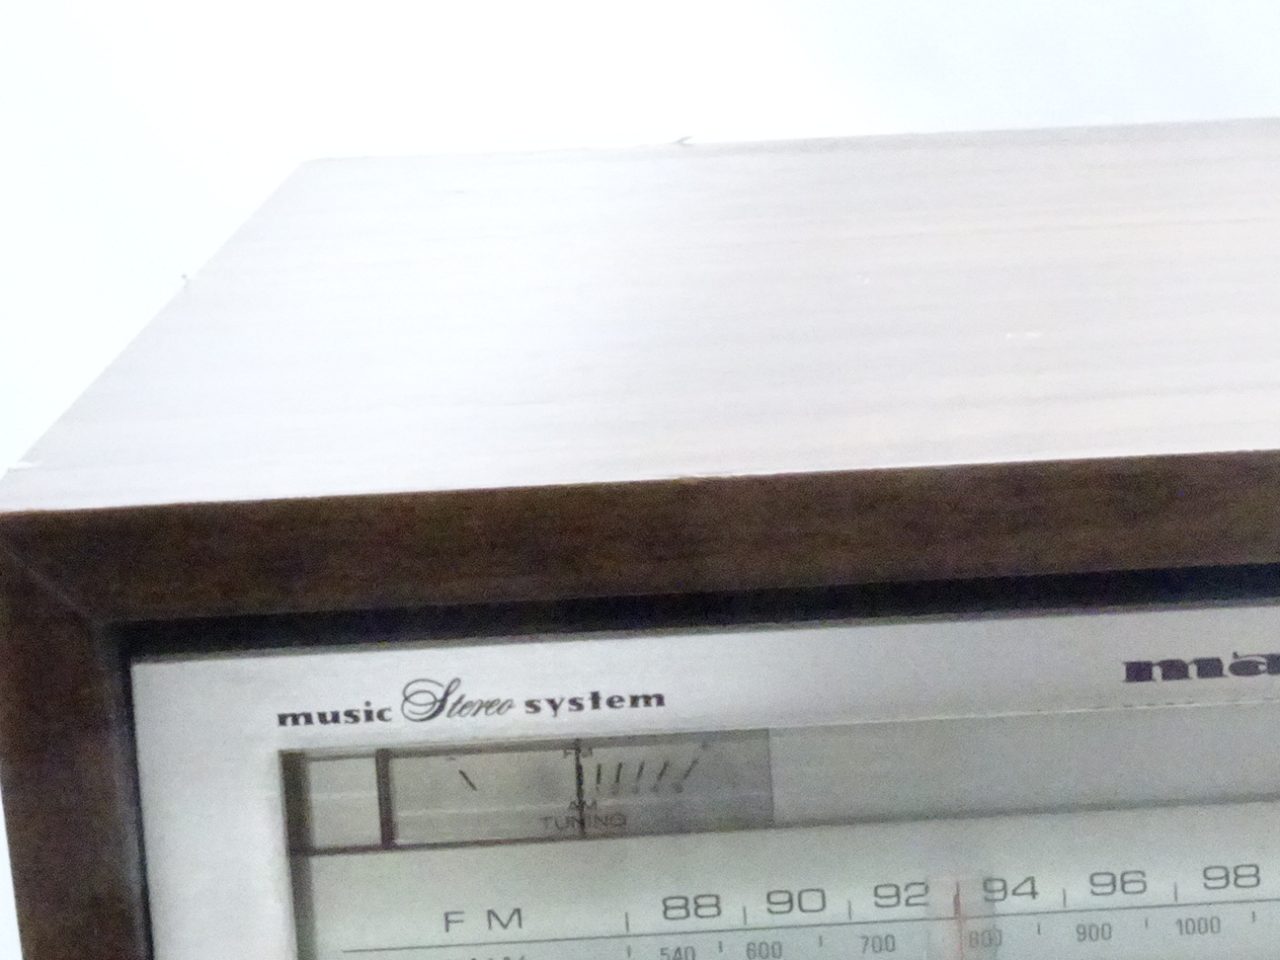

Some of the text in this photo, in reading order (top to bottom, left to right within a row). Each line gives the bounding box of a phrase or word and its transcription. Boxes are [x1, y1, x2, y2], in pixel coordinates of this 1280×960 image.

[277, 678, 667, 727] music Stereo system
[540, 811, 628, 831] TUNING
[661, 893, 722, 921] 88
[765, 888, 827, 916] 90
[872, 881, 930, 909] 92
[982, 876, 1040, 903] 94
[1088, 870, 1148, 897] 96
[1202, 864, 1261, 891] 98
[745, 940, 784, 960] 600
[860, 933, 897, 955] 700
[1075, 921, 1113, 943] 900
[1174, 915, 1221, 938] 1000
